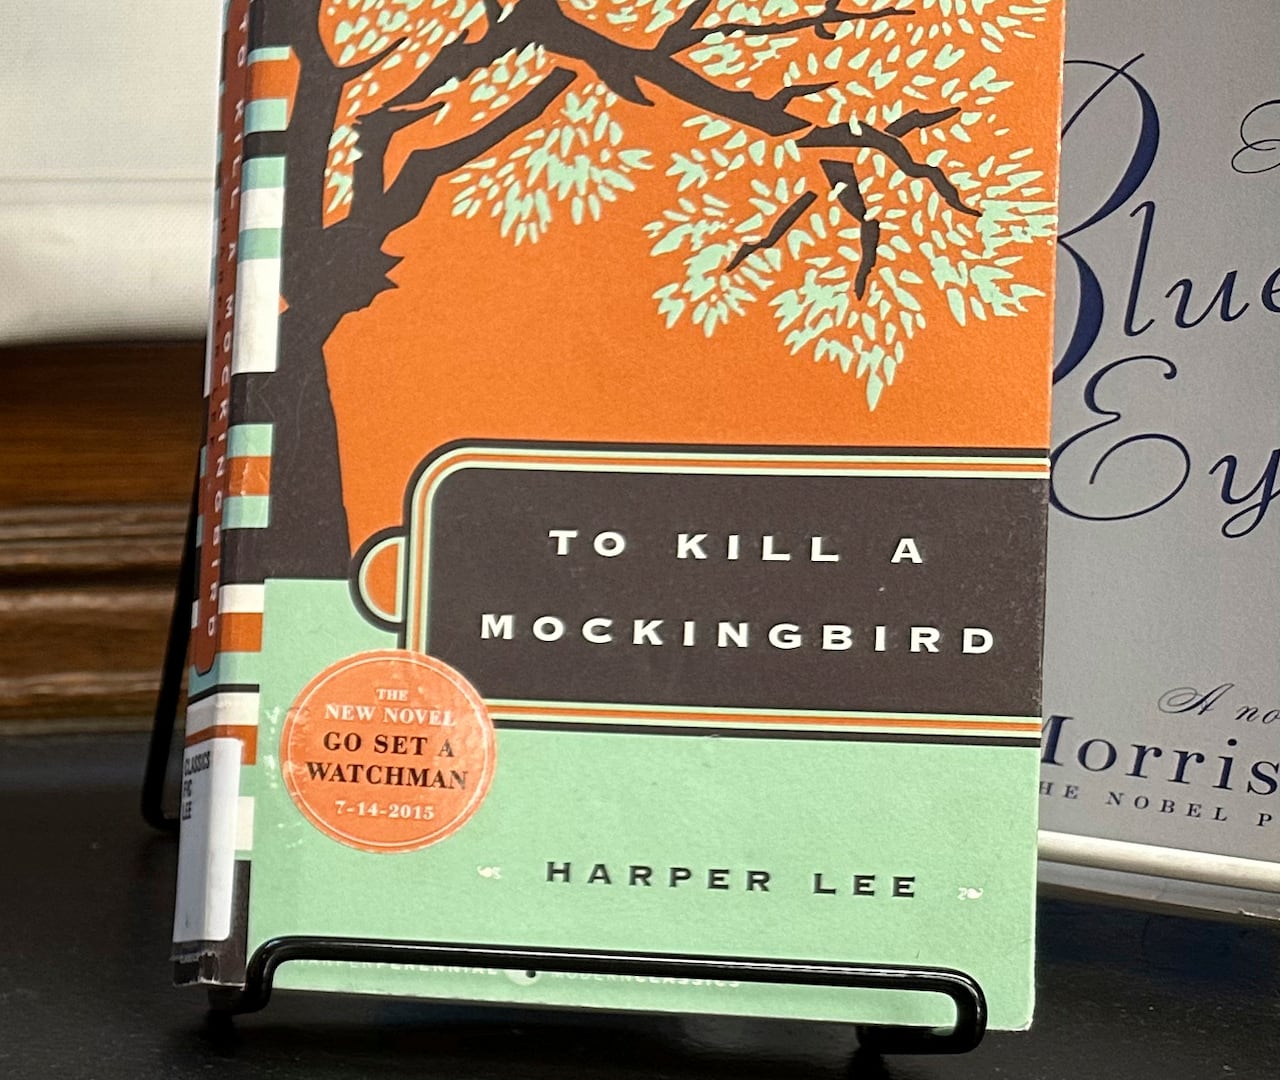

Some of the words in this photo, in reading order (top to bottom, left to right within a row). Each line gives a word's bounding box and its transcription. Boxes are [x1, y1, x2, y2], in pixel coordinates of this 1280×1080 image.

[548, 529, 627, 558] TO
[676, 532, 841, 563] KILL
[890, 538, 924, 565] A
[480, 612, 996, 655] MOCKINGBIRD
[375, 687, 409, 702] THE
[1157, 682, 1236, 716] A
[324, 704, 377, 721] NEW
[383, 706, 456, 727] NOVEL
[323, 731, 363, 752] GO
[373, 733, 428, 756] SET
[437, 738, 455, 758] A
[304, 761, 469, 790] WATCHMAN
[334, 800, 435, 820] 7-14-2015
[1105, 791, 1229, 822] NOBEL
[545, 860, 772, 893] HARPER
[812, 872, 916, 899] LEE
